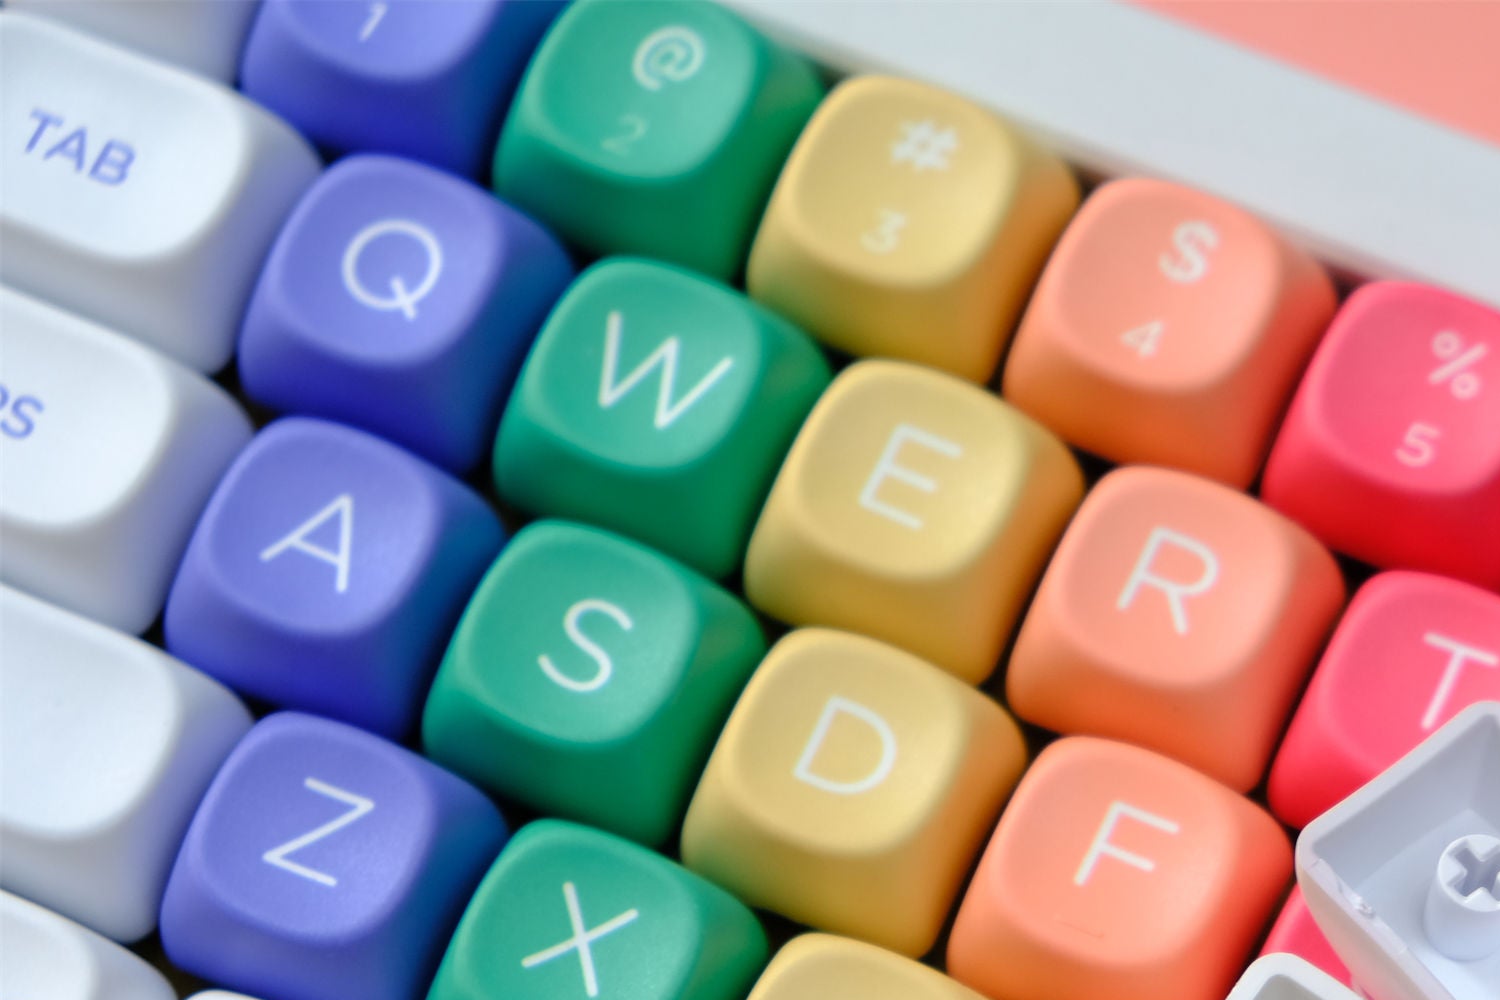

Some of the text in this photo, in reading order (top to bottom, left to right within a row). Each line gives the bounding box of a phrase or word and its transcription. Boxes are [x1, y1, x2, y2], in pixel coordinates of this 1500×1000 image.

[360, 0, 387, 40] 1
[633, 27, 705, 90] @
[26, 110, 135, 185] TAB
[601, 114, 648, 155] 2
[891, 120, 962, 172] #
[342, 219, 443, 319] Q
[860, 209, 907, 253] 3
[1160, 219, 1220, 283] $
[600, 312, 733, 428] W
[1120, 321, 1164, 360] 4
[1428, 330, 1488, 398] %
[0, 383, 44, 440] S
[1394, 423, 1441, 467] 5
[858, 423, 962, 529] E
[261, 495, 353, 593] A
[1117, 526, 1220, 634] R
[538, 599, 633, 692] S
[1424, 633, 1500, 730] T
[793, 696, 898, 795] D
[263, 777, 374, 886] Z
[1074, 801, 1179, 886] F
[522, 882, 638, 997] X
